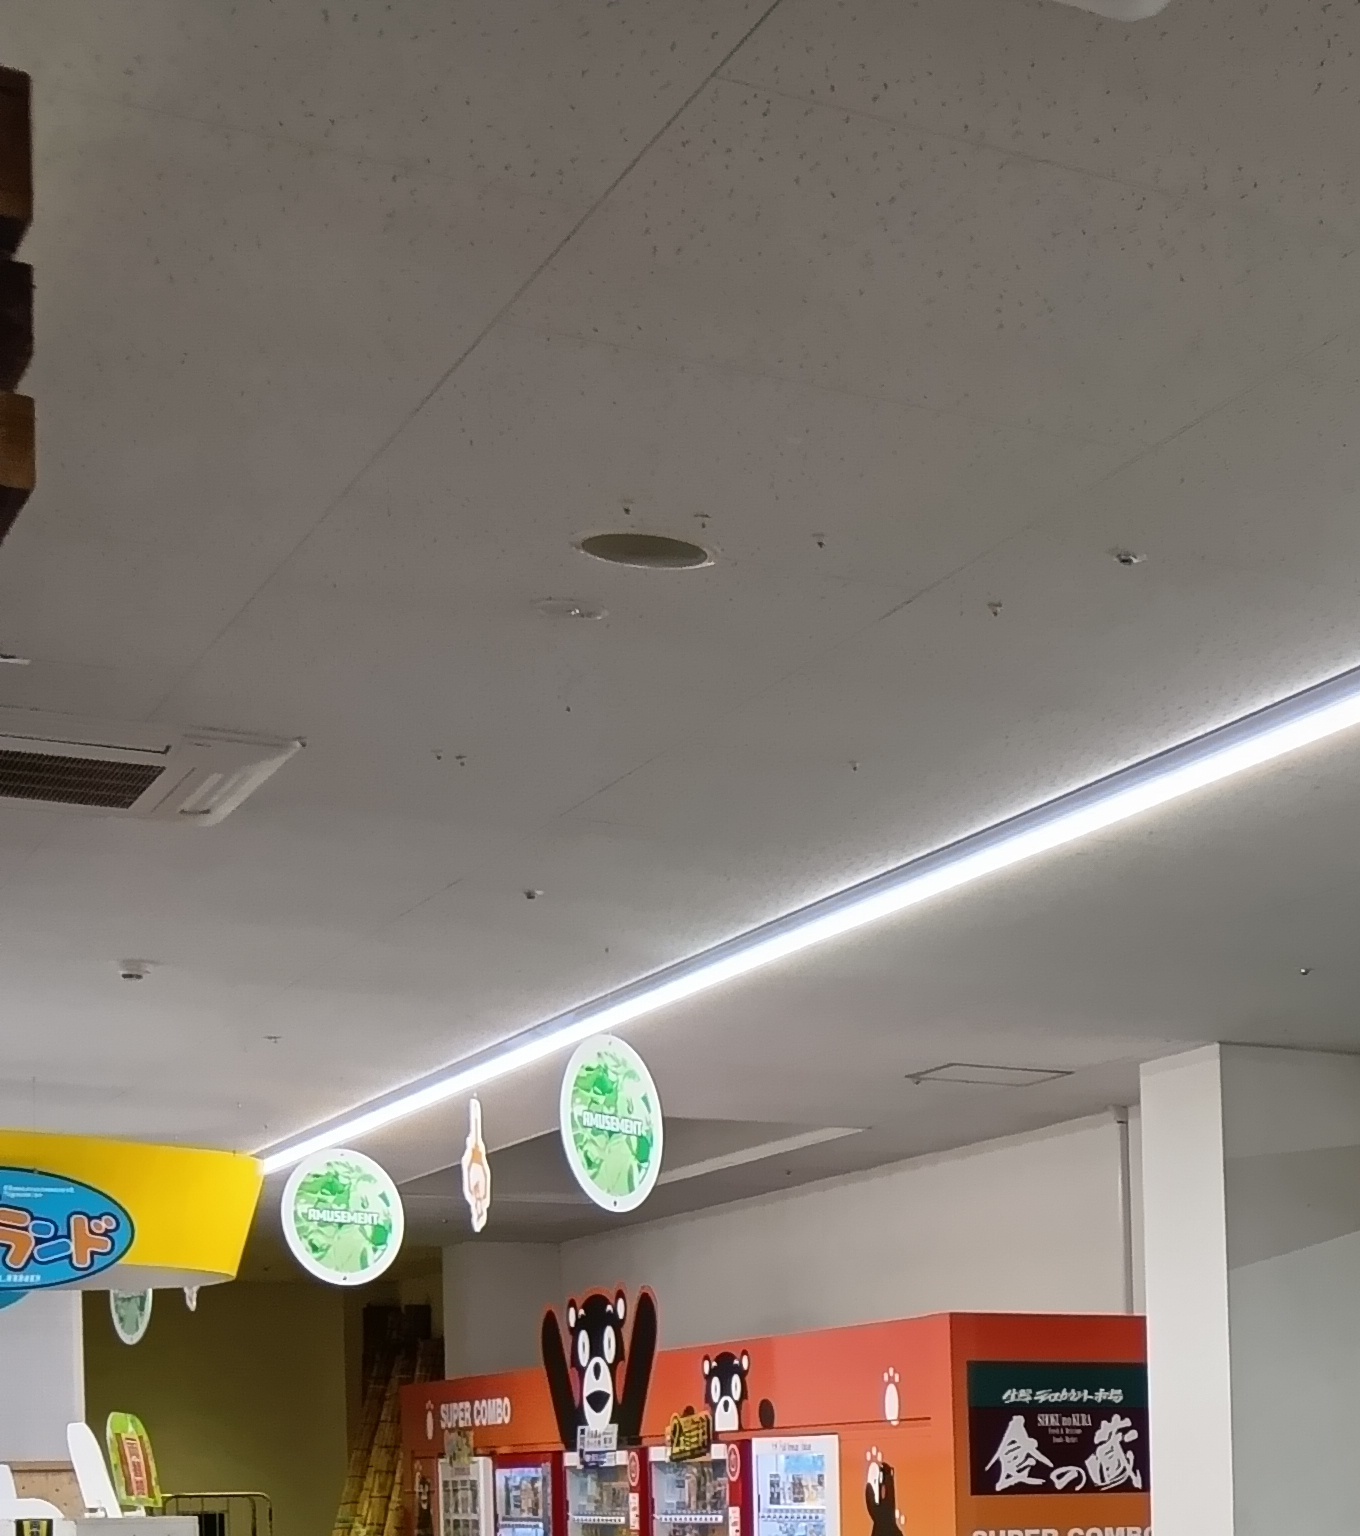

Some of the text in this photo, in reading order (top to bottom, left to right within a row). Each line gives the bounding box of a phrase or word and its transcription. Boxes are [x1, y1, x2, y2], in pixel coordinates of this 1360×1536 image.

[582, 1108, 645, 1137] AMUSEMENT
[306, 1208, 381, 1227] AMUSEMENT
[439, 1396, 511, 1429] SUPER COMBO
[984, 1413, 1143, 1492] 食の蔵
